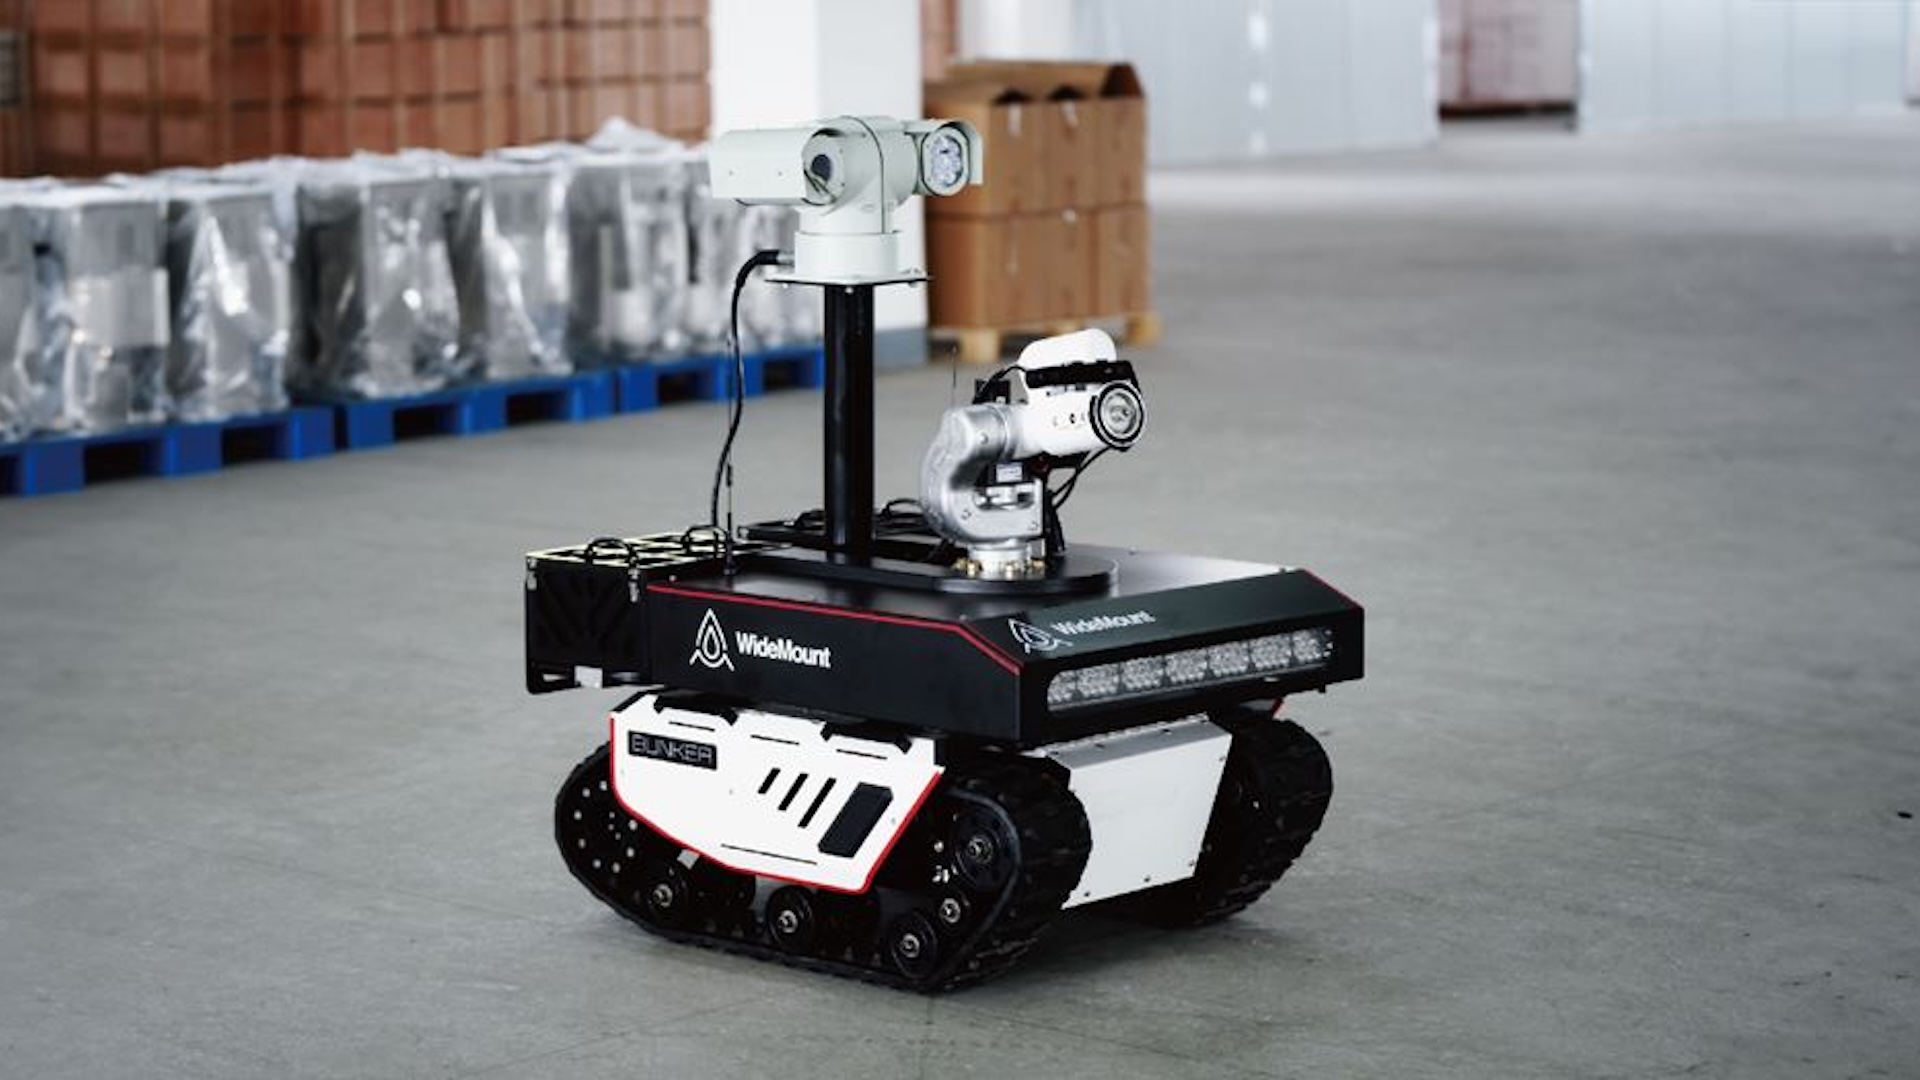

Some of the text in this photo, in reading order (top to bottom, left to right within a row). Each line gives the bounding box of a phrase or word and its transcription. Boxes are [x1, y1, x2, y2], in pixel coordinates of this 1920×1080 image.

[1051, 610, 1156, 635] WideMount
[735, 630, 831, 668] WideMount
[631, 733, 712, 763] BUNKER
